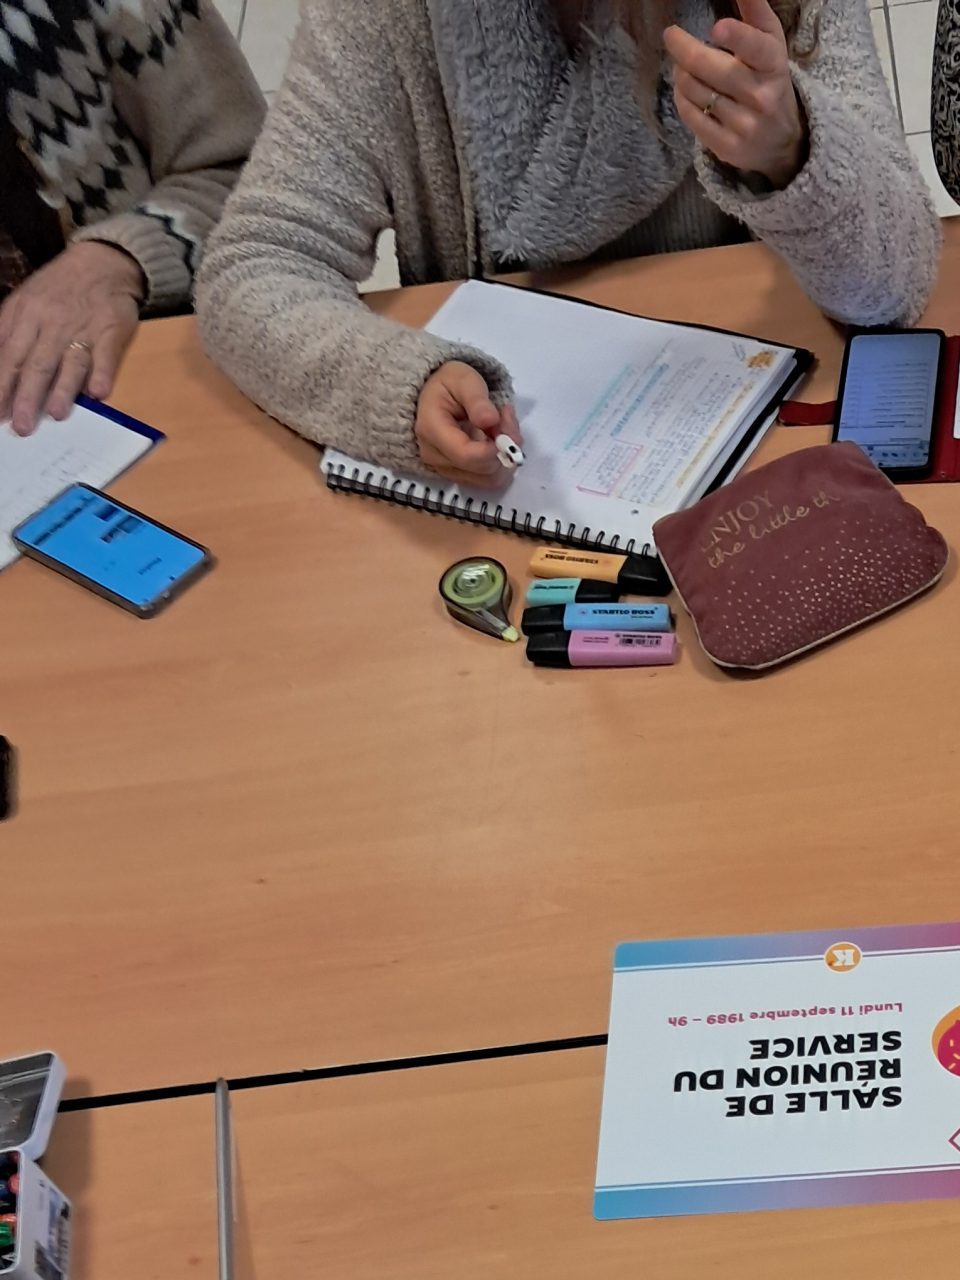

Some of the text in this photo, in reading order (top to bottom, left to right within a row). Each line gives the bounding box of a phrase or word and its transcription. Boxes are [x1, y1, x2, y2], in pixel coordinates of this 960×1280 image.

[709, 541, 745, 569] the
[749, 1005, 836, 1023] septembre
[840, 1005, 854, 1016] 11
[858, 1002, 903, 1015] Lundi
[668, 1016, 688, 1027] 9h
[707, 1012, 744, 1026] 1989
[749, 1030, 902, 1060] SERVICE
[673, 1057, 902, 1093] RÉUNION DU
[724, 1086, 902, 1117] SALLE DE
